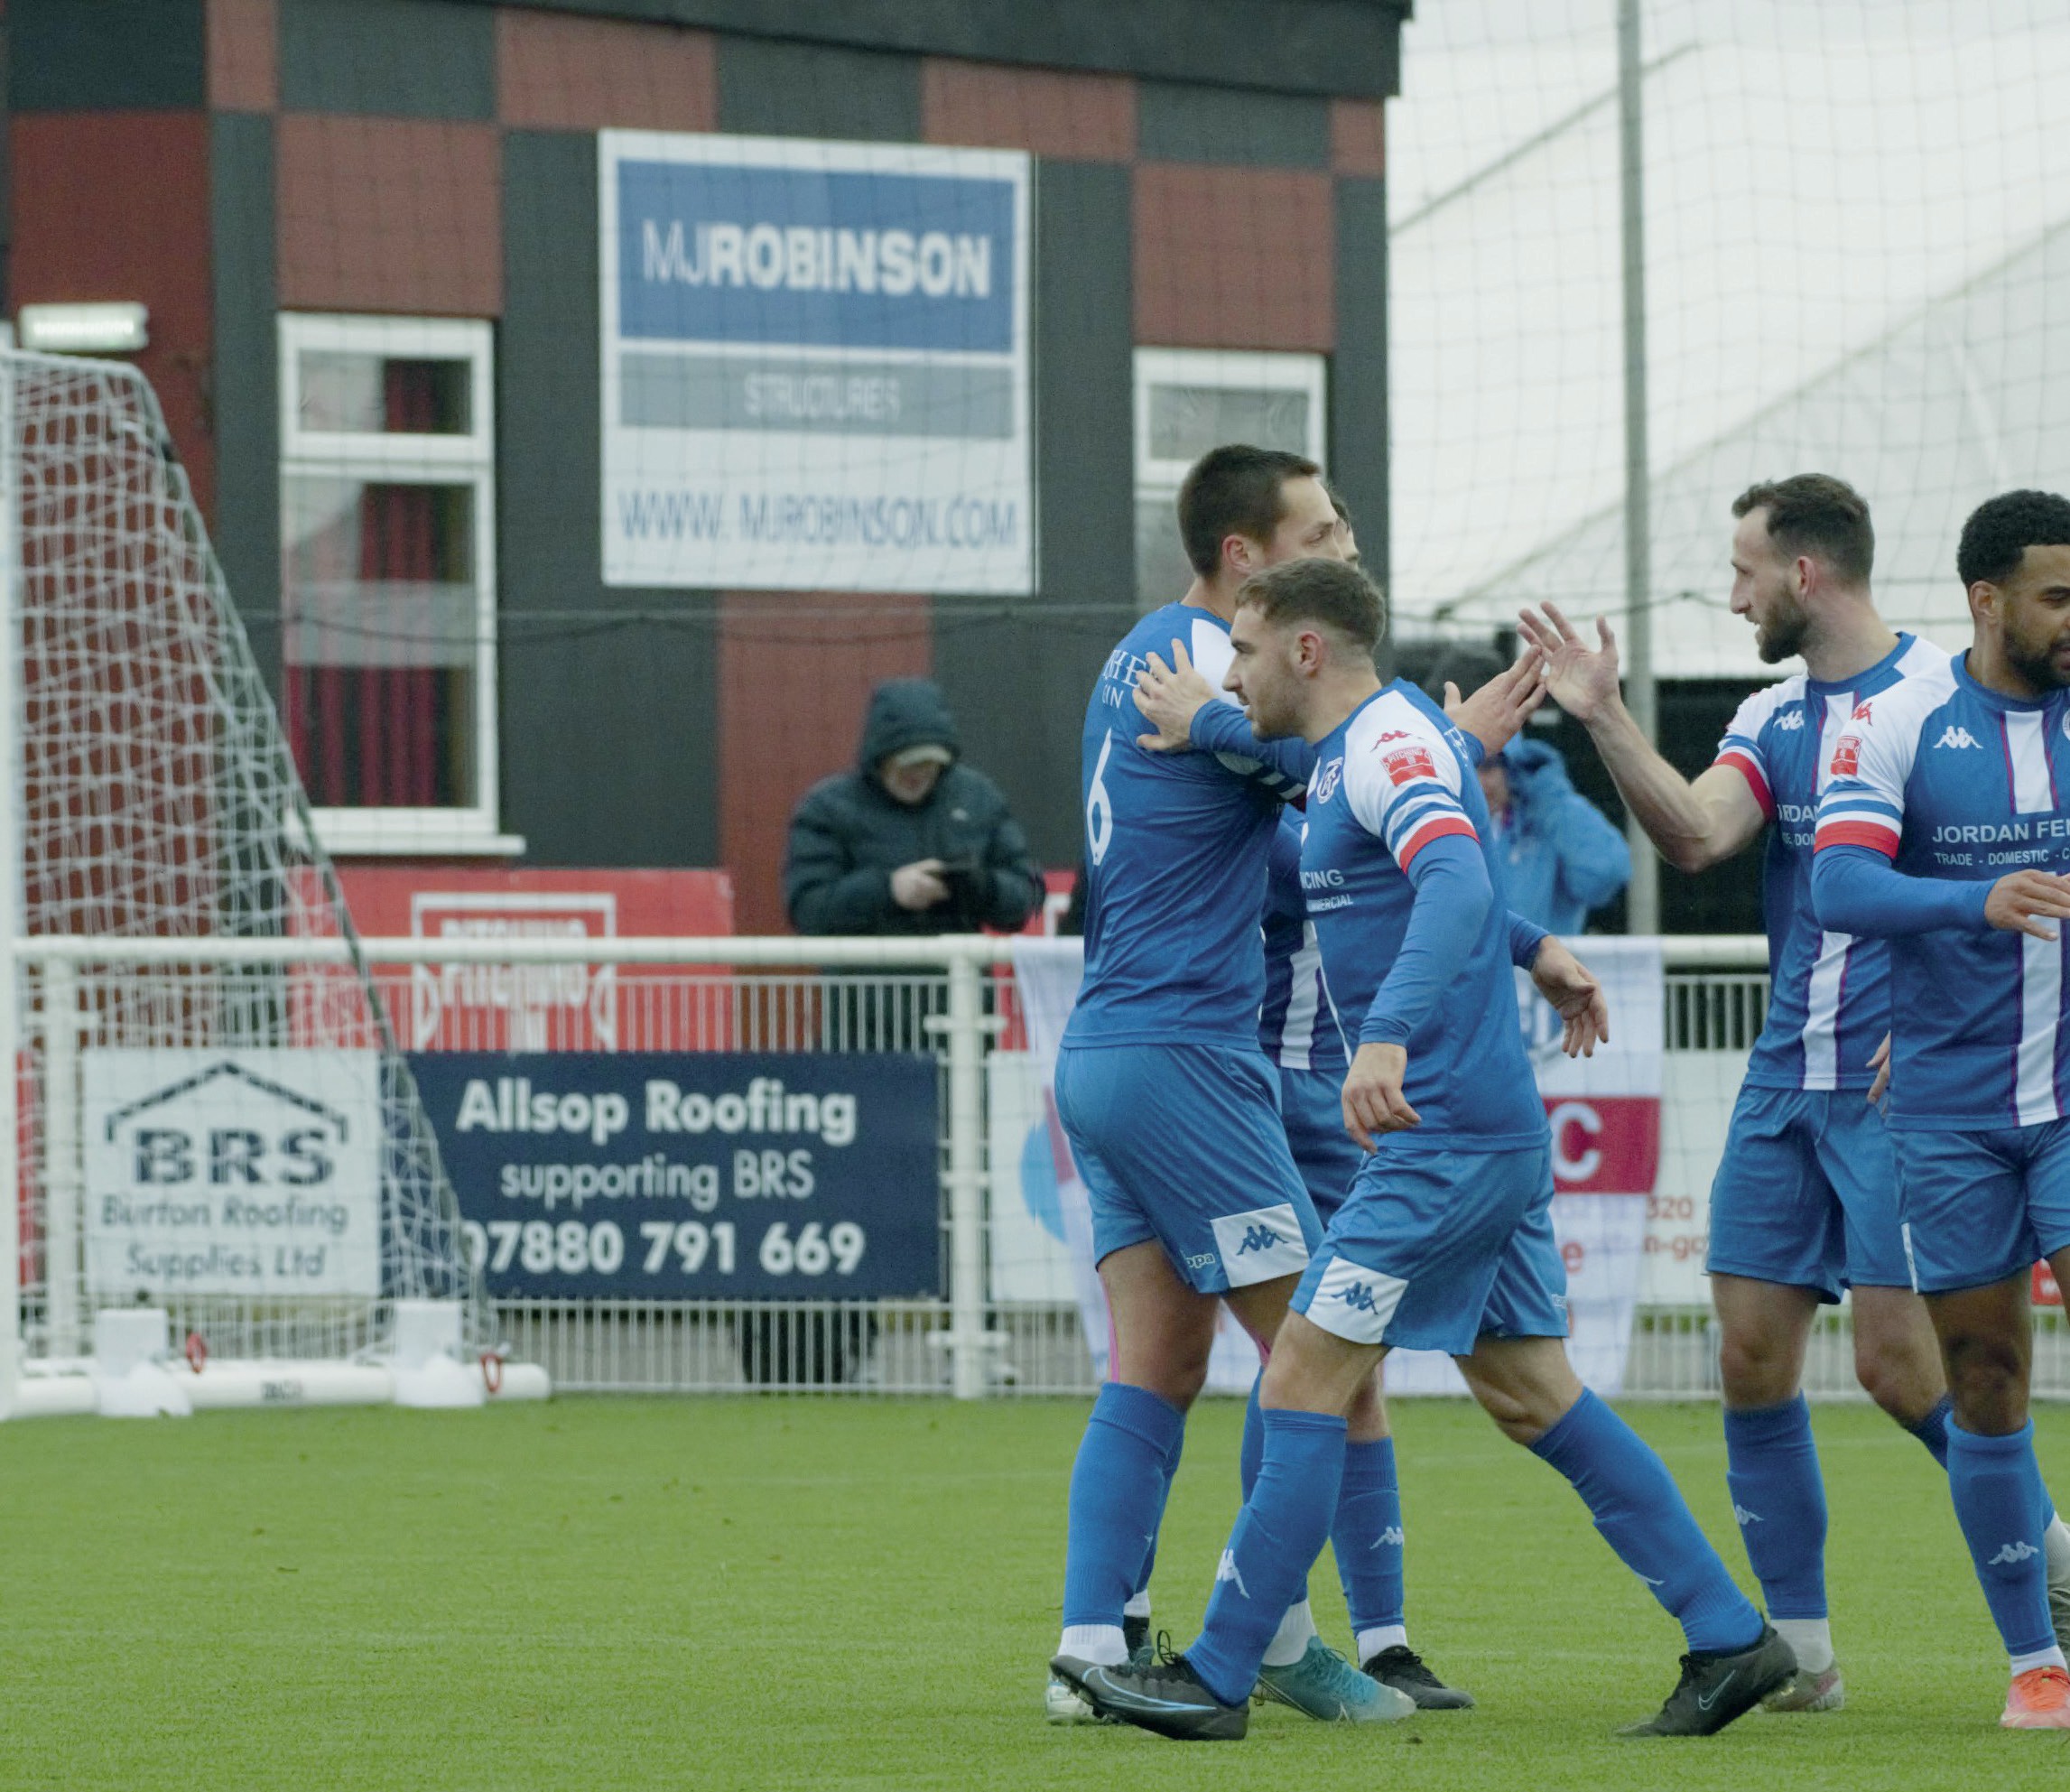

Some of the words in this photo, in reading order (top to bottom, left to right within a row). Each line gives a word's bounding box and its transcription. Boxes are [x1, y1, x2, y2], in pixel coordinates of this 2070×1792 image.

[1086, 726, 1114, 866] 6
[1932, 822, 2030, 844] JORDAN
[1933, 851, 1973, 867] TRADE
[1988, 849, 2050, 866] DOMESTIC
[455, 1076, 630, 1147] Allsop
[645, 1075, 858, 1147] Roofing
[134, 1128, 334, 1186] BRS
[500, 1151, 719, 1213] supporting
[732, 1148, 816, 1200] BRS
[101, 1193, 211, 1227] Burton
[222, 1193, 349, 1236] Roofing
[127, 1242, 262, 1282] Supplies
[274, 1243, 328, 1277] Ltd
[639, 1221, 737, 1275] 791
[758, 1221, 867, 1276] 669
